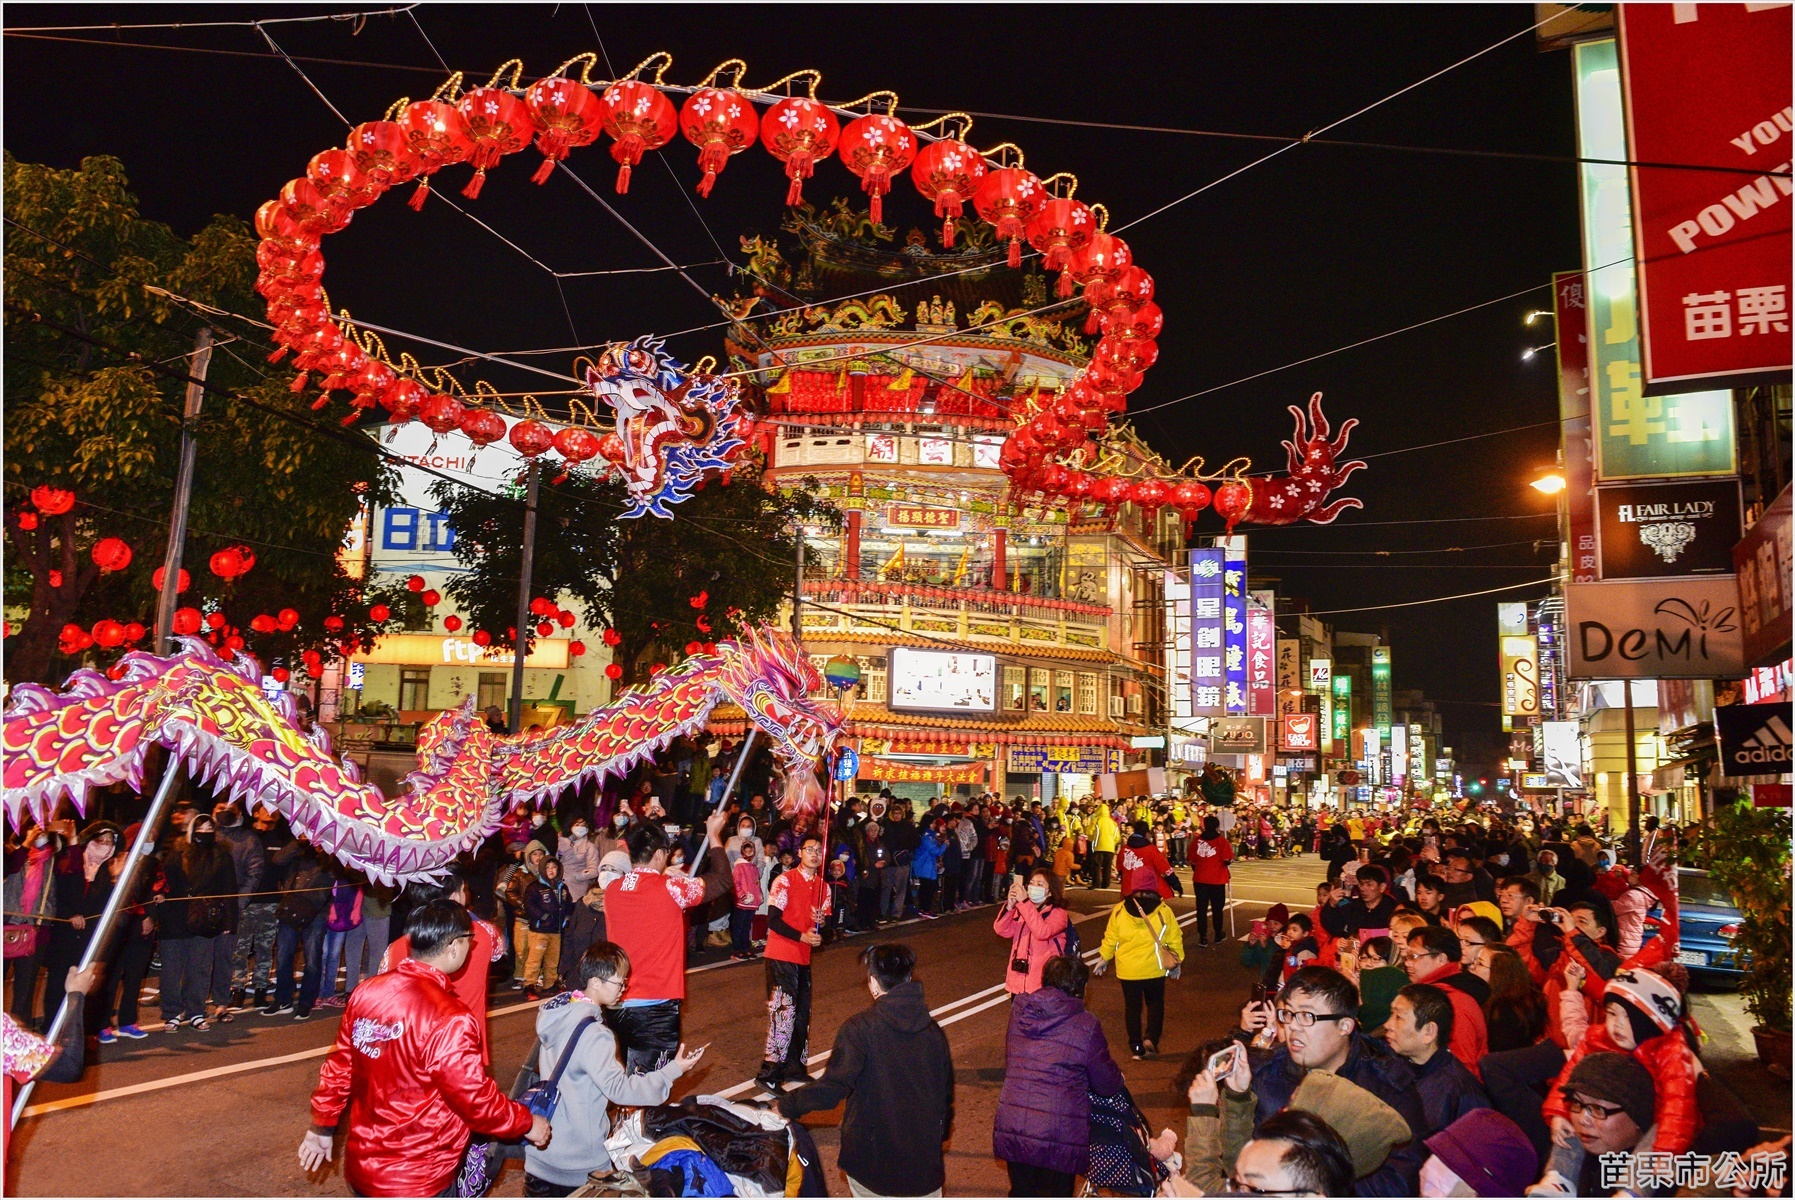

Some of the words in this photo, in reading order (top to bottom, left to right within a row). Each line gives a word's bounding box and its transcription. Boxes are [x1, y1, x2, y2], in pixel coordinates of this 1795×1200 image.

[1668, 148, 1793, 254] POWE
[1682, 285, 1790, 341] 苗栗
[1636, 503, 1672, 516] FAIR
[1674, 500, 1716, 513] LADY
[442, 638, 485, 663] ftp
[1196, 597, 1221, 708] 星創眼鏡
[1288, 733, 1307, 741] EASY
[1289, 739, 1312, 747] SHOP
